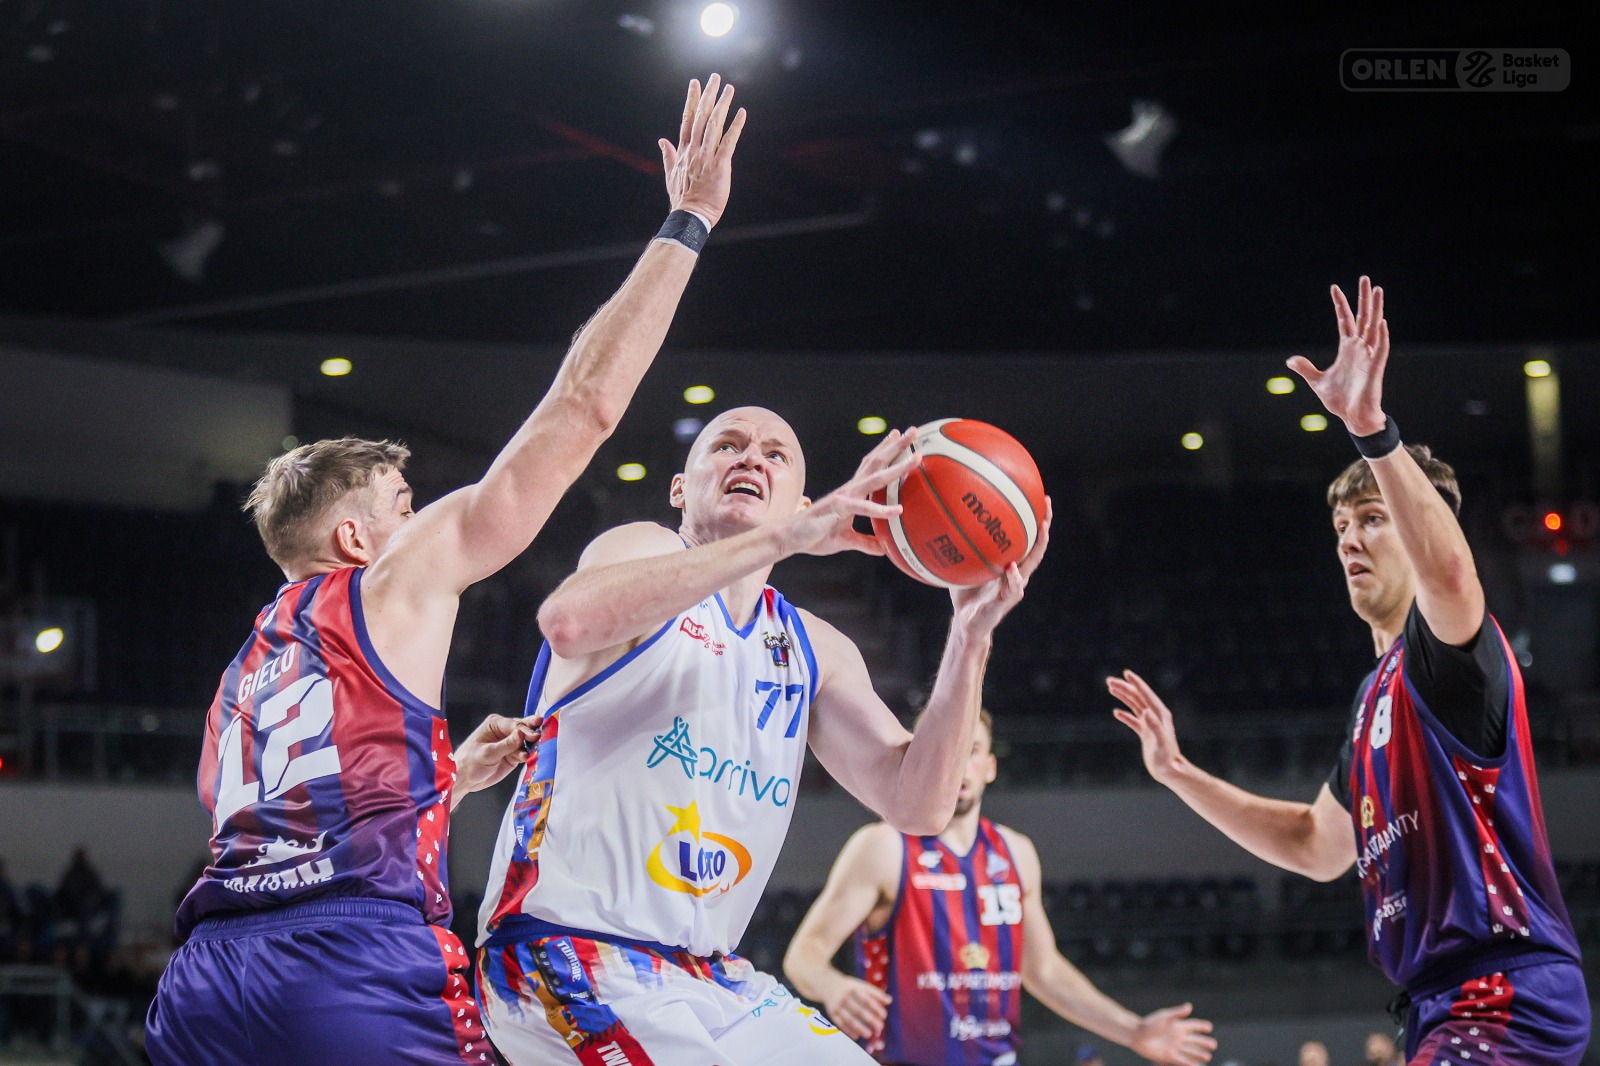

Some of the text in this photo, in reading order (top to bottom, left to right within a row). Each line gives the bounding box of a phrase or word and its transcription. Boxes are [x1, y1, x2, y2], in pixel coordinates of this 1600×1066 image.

[961, 491, 1012, 553] molten
[237, 641, 297, 705] GIELO
[755, 679, 804, 738] 77
[215, 673, 342, 836] 12
[699, 747, 791, 807] arriva
[977, 883, 1022, 926] 15
